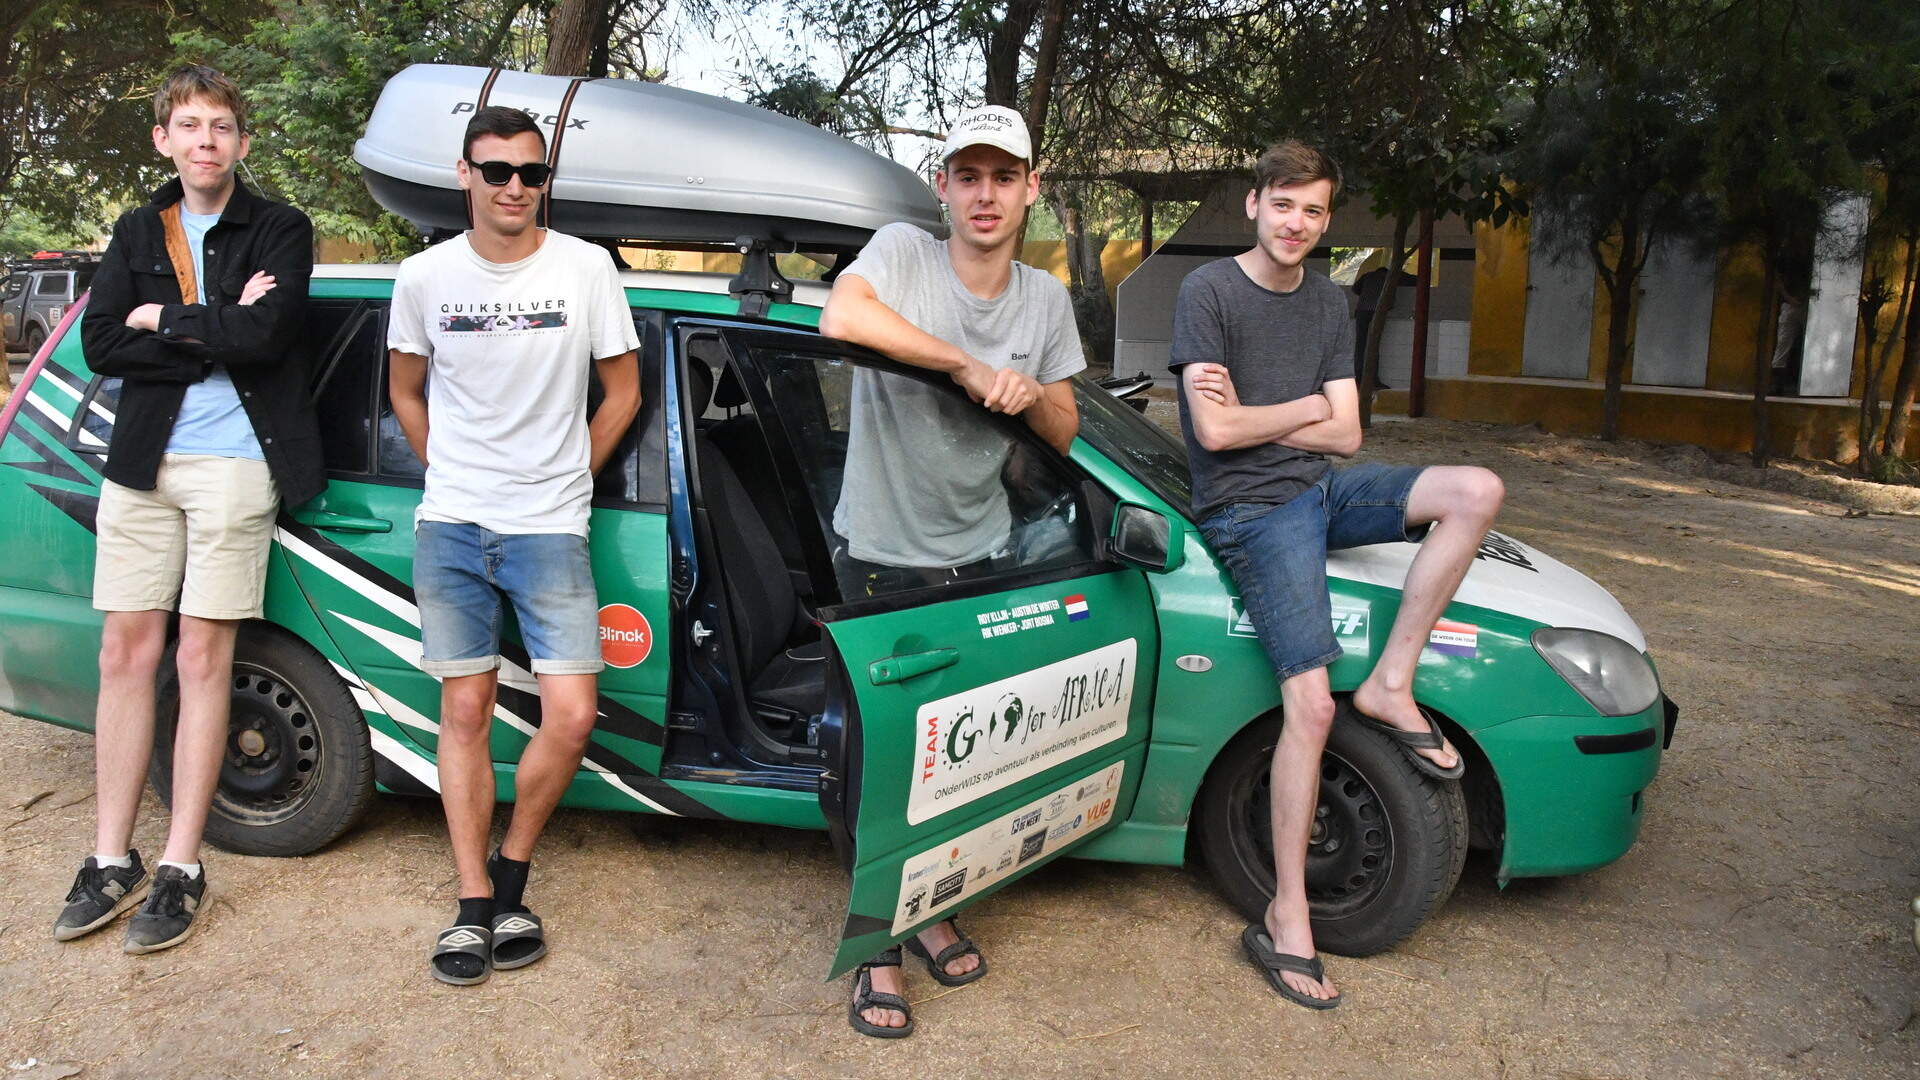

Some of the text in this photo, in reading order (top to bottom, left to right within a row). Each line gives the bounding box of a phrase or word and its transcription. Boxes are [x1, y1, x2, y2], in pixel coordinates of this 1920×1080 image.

[960, 113, 1013, 128] RHODES
[440, 299, 566, 314] QUIKSILVER
[1021, 704, 1047, 745] for
[922, 716, 939, 784] TEAM
[982, 770, 994, 782] op
[994, 756, 1029, 777] avontuur
[1029, 749, 1041, 761] als
[1041, 735, 1078, 757] verbinding
[1078, 730, 1091, 743] van
[1091, 720, 1117, 738] culturen
